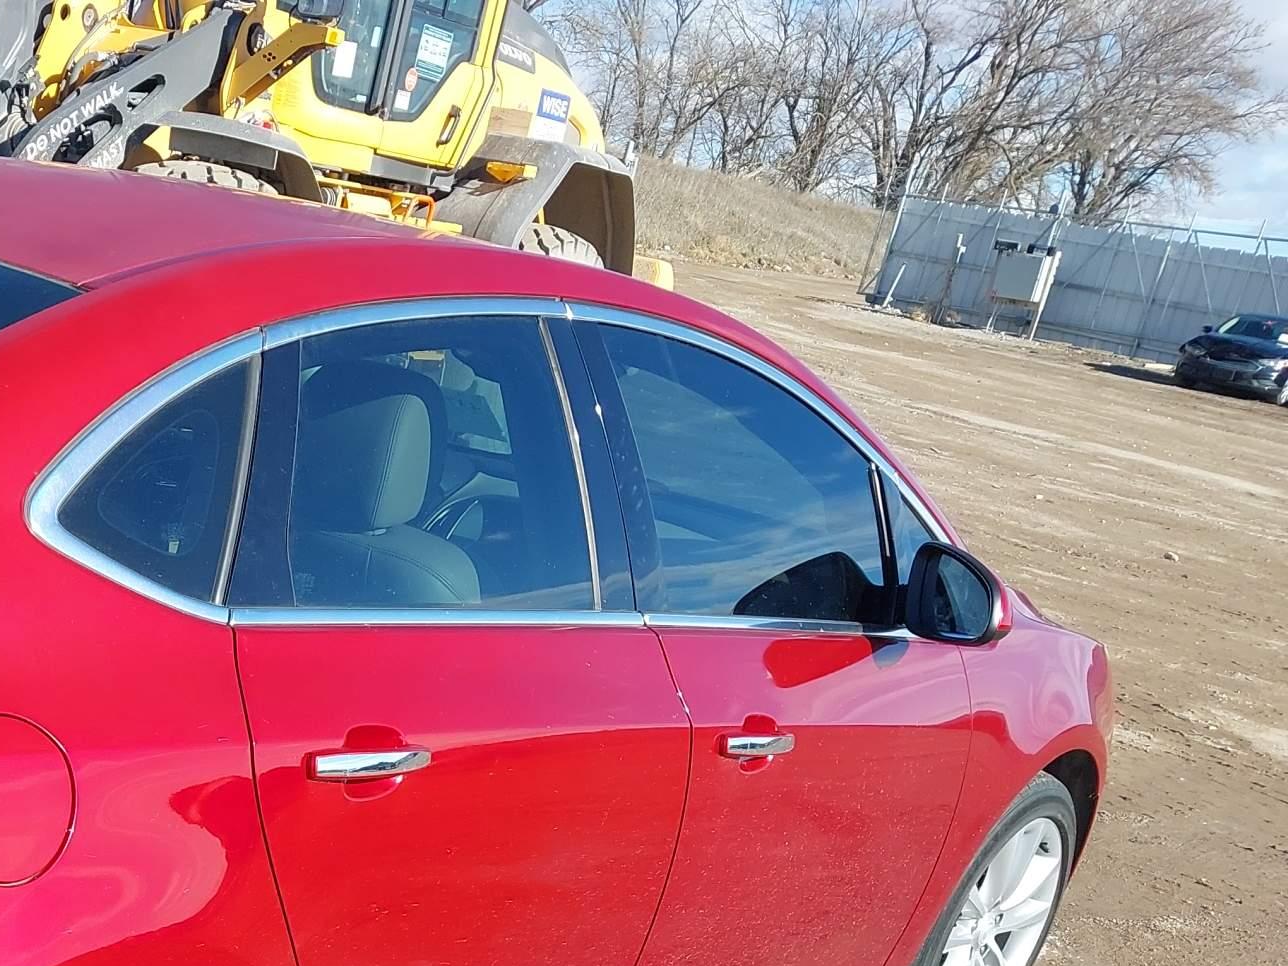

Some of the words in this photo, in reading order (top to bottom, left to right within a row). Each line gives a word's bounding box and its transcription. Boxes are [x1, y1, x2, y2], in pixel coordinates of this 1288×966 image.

[25, 134, 48, 160] DO
[49, 111, 79, 142] NOT
[80, 81, 124, 118] WALK
[542, 94, 569, 118] WISE
